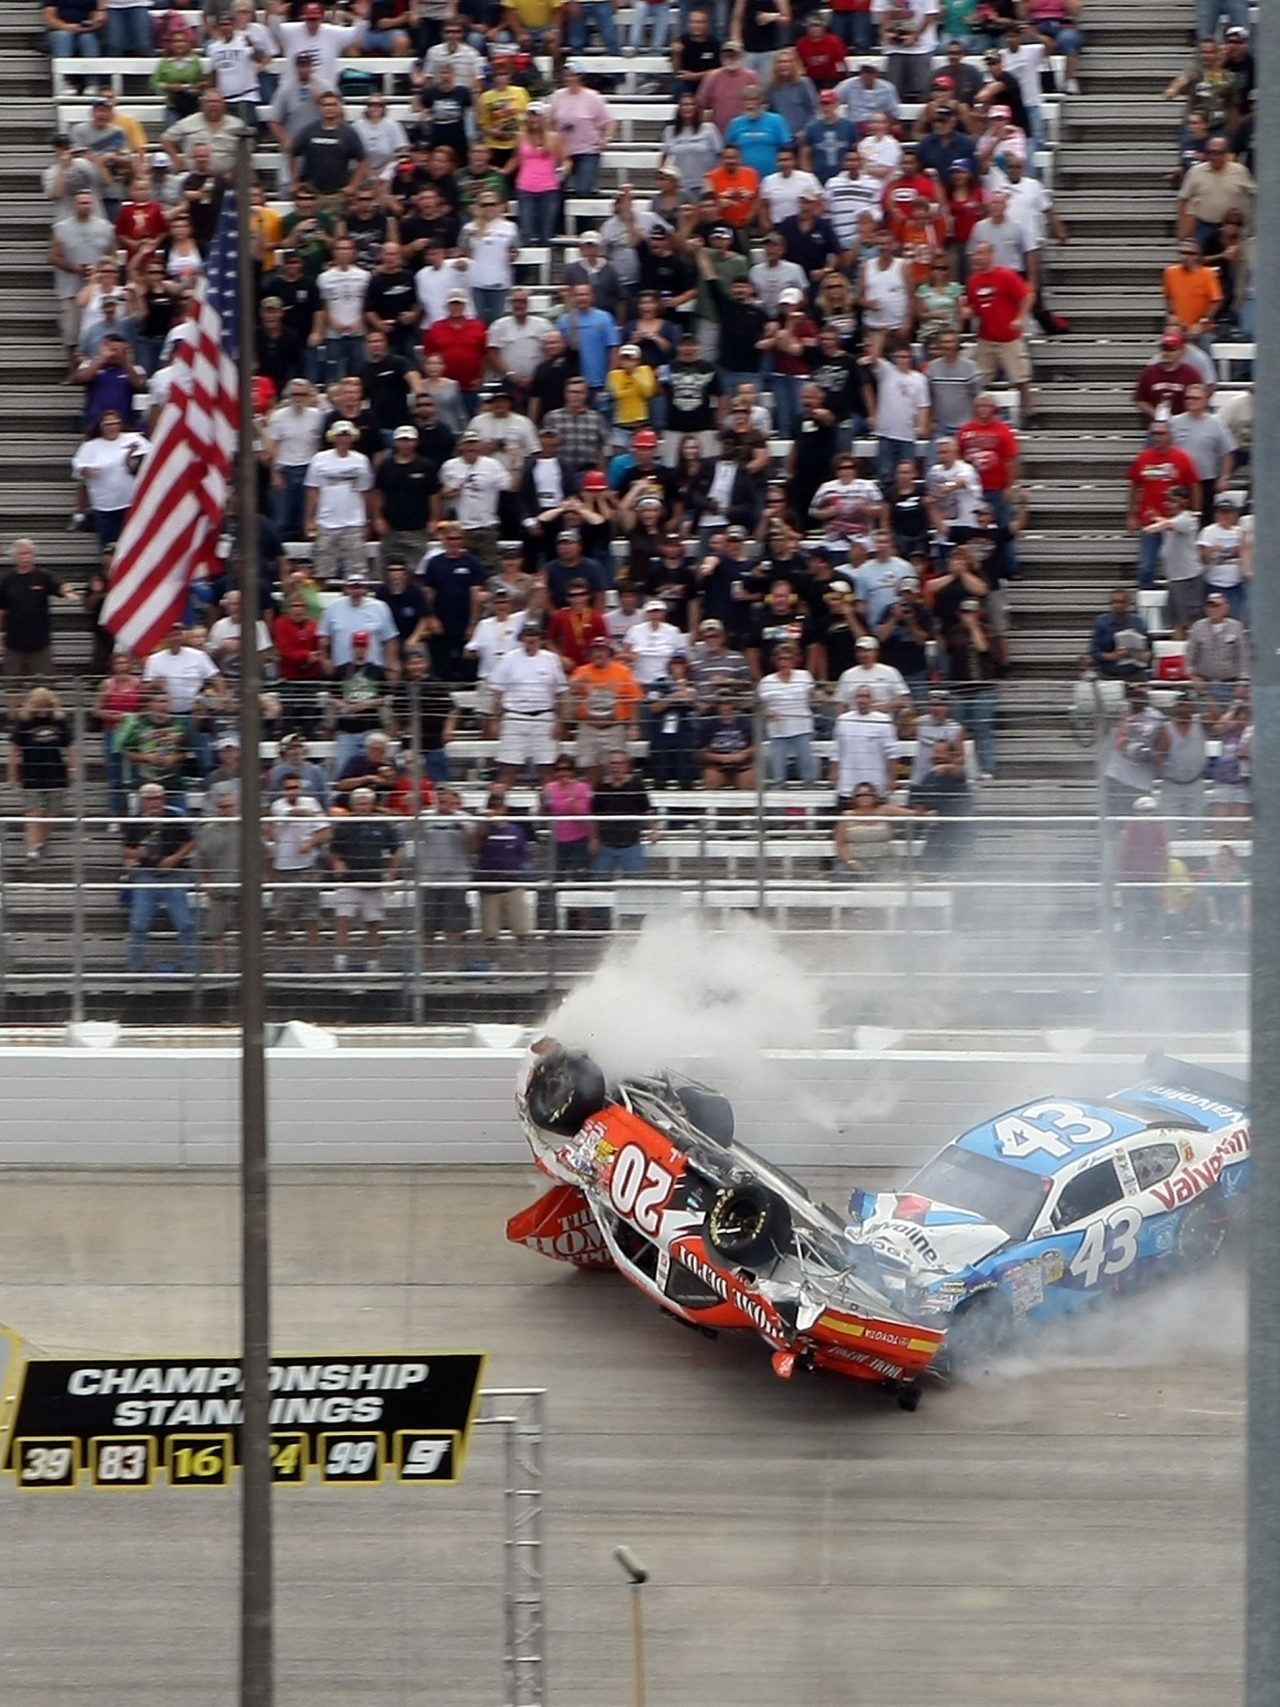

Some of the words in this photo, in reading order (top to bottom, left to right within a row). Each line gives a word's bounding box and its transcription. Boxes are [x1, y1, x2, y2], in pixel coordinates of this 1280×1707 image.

[995, 1102, 1114, 1159] 43
[609, 1142, 673, 1238] 20
[1150, 1126, 1251, 1211] Valvolin
[680, 1245, 729, 1300] DEPOT
[1069, 1206, 1143, 1288] 43
[864, 1328, 900, 1345] TOYOTA
[67, 1363, 429, 1396] CHAMPONSHIP
[113, 1396, 384, 1428] STANINGS
[21, 1447, 73, 1481] 39
[96, 1445, 147, 1481] 83
[173, 1444, 222, 1478] 16
[268, 1443, 302, 1475] 4
[325, 1441, 377, 1475] 99
